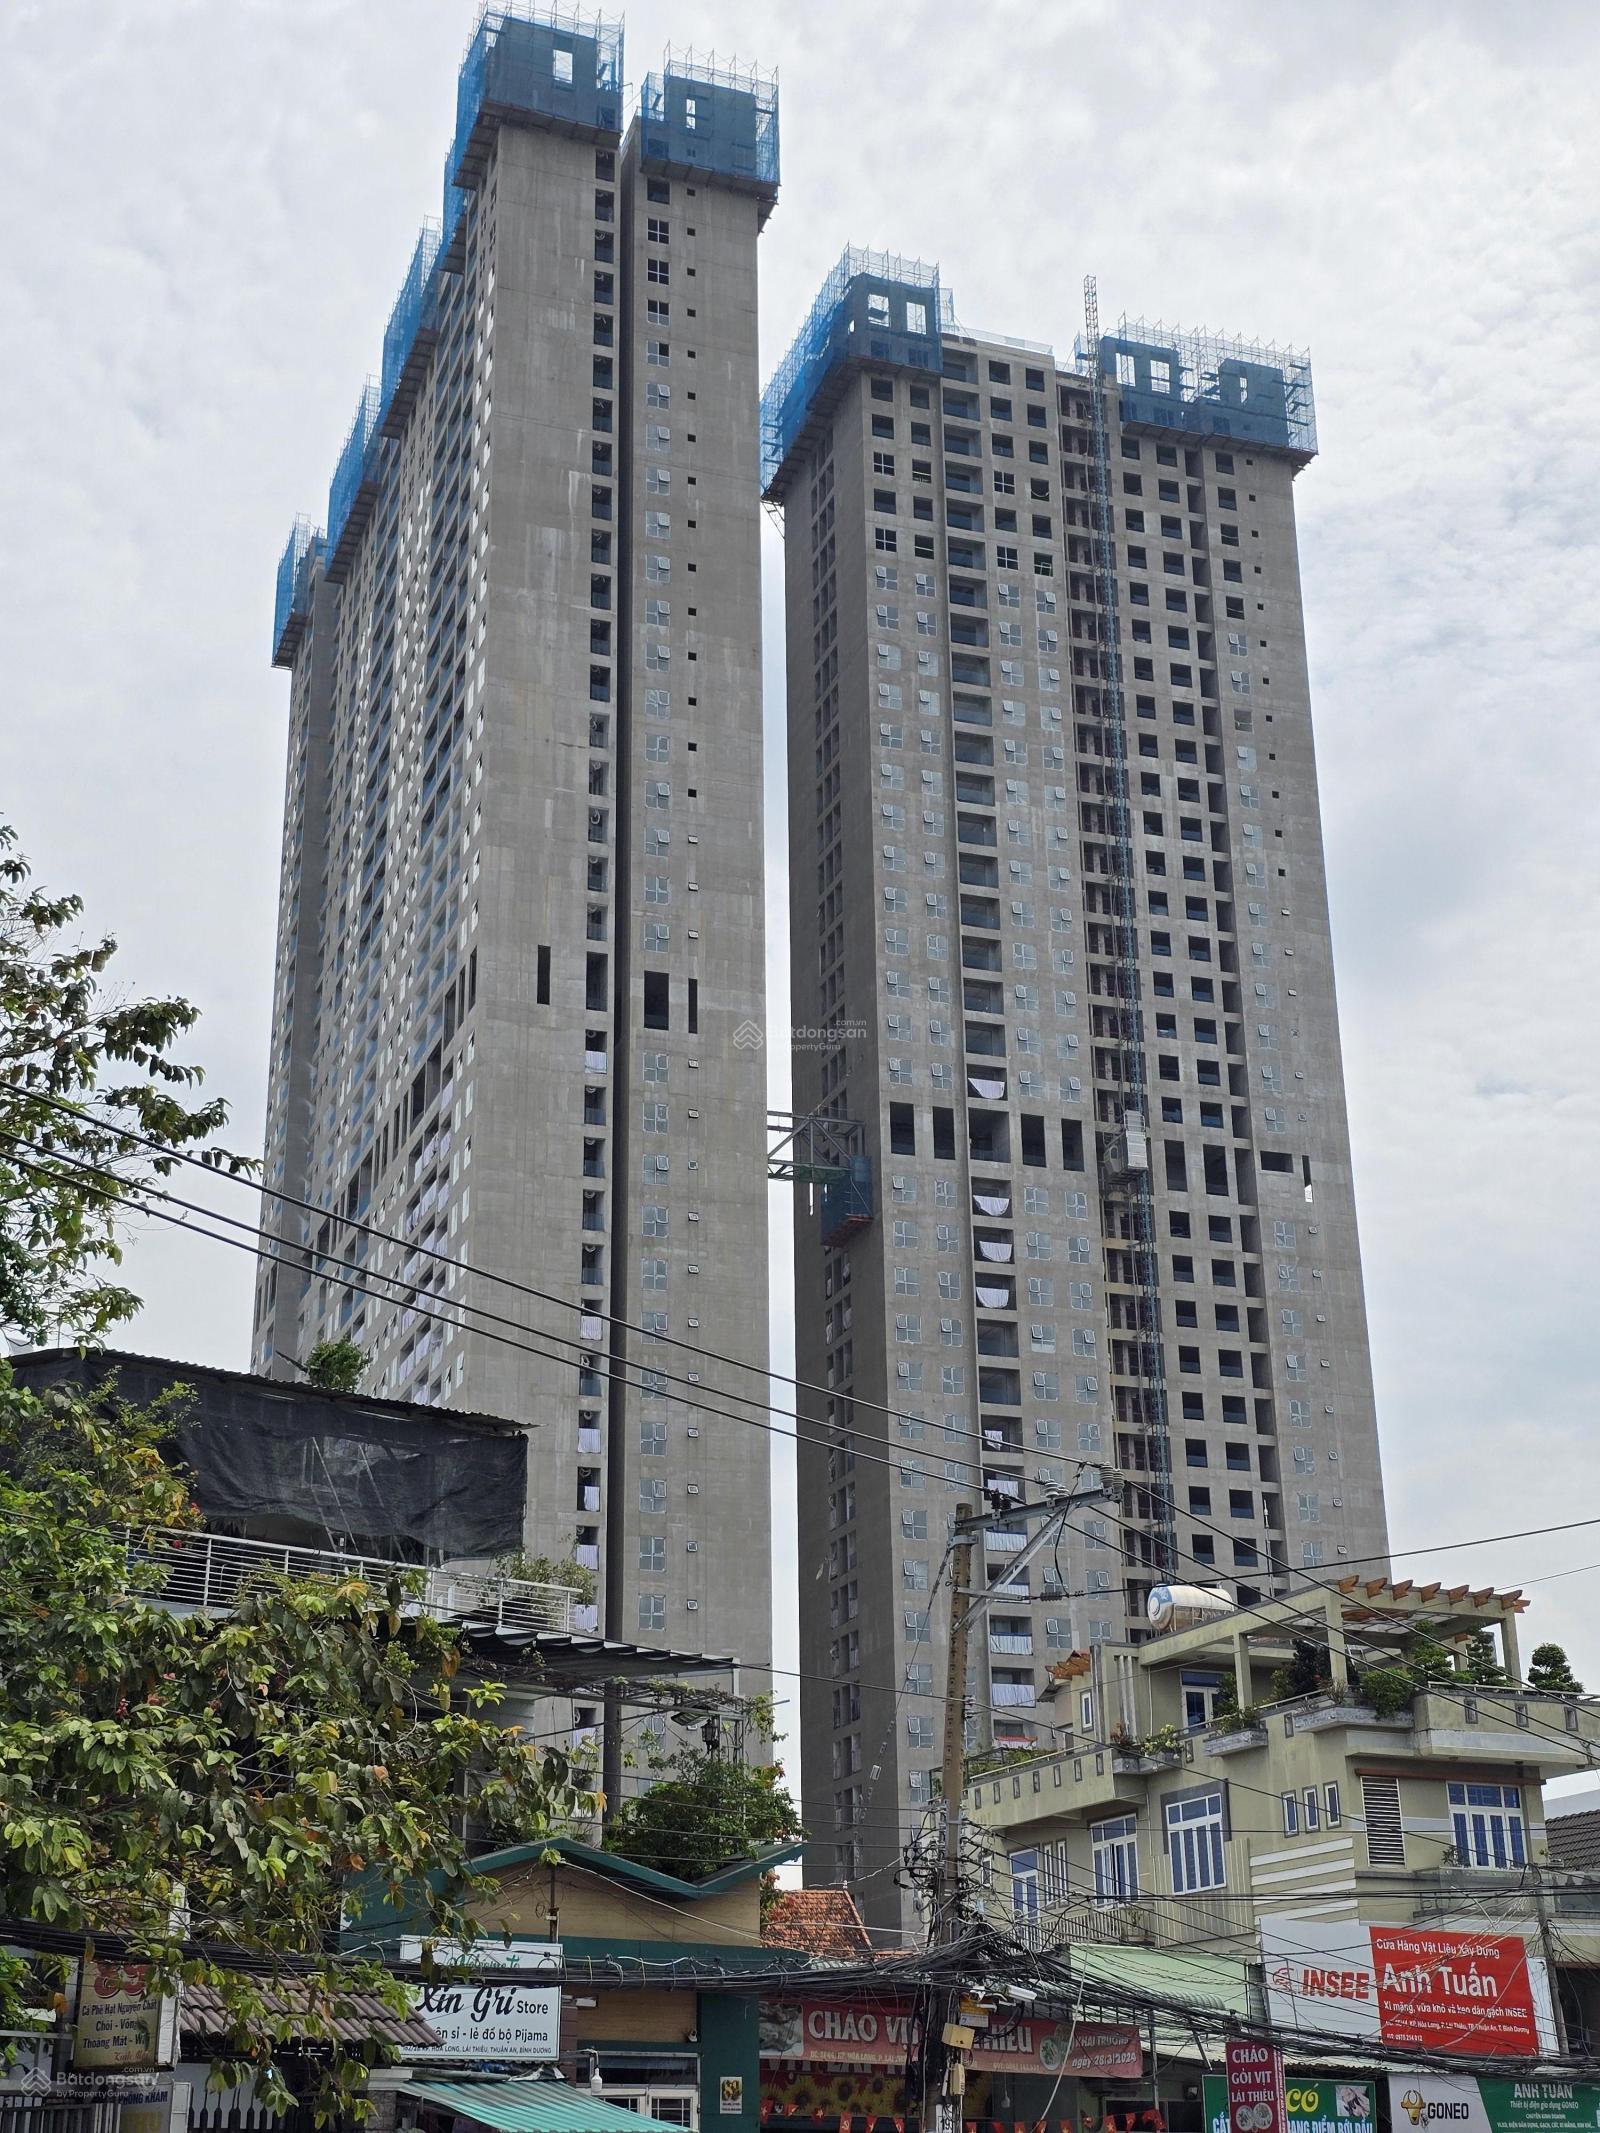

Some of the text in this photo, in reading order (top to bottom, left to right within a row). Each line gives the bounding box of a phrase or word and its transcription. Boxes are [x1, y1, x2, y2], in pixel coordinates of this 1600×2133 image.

[1397, 1939, 1420, 1954] Hàng
[1421, 1941, 1436, 1955] Vật
[1301, 1969, 1370, 1999] INSEE
[1383, 1962, 1498, 1997] Anh Tuấn
[517, 2000, 548, 2014] Store
[499, 2028, 512, 2044] bộ
[515, 2028, 548, 2043] Pijama
[808, 2010, 878, 2042] CHÁO
[973, 2019, 1033, 2053] HIÊU
[1232, 2045, 1268, 2063] CHÁO
[1254, 2071, 1272, 2086] VỊT
[1231, 2089, 1245, 2102] LÁI
[1514, 2083, 1540, 2098] ANH
[1427, 2102, 1470, 2120] GONEO
